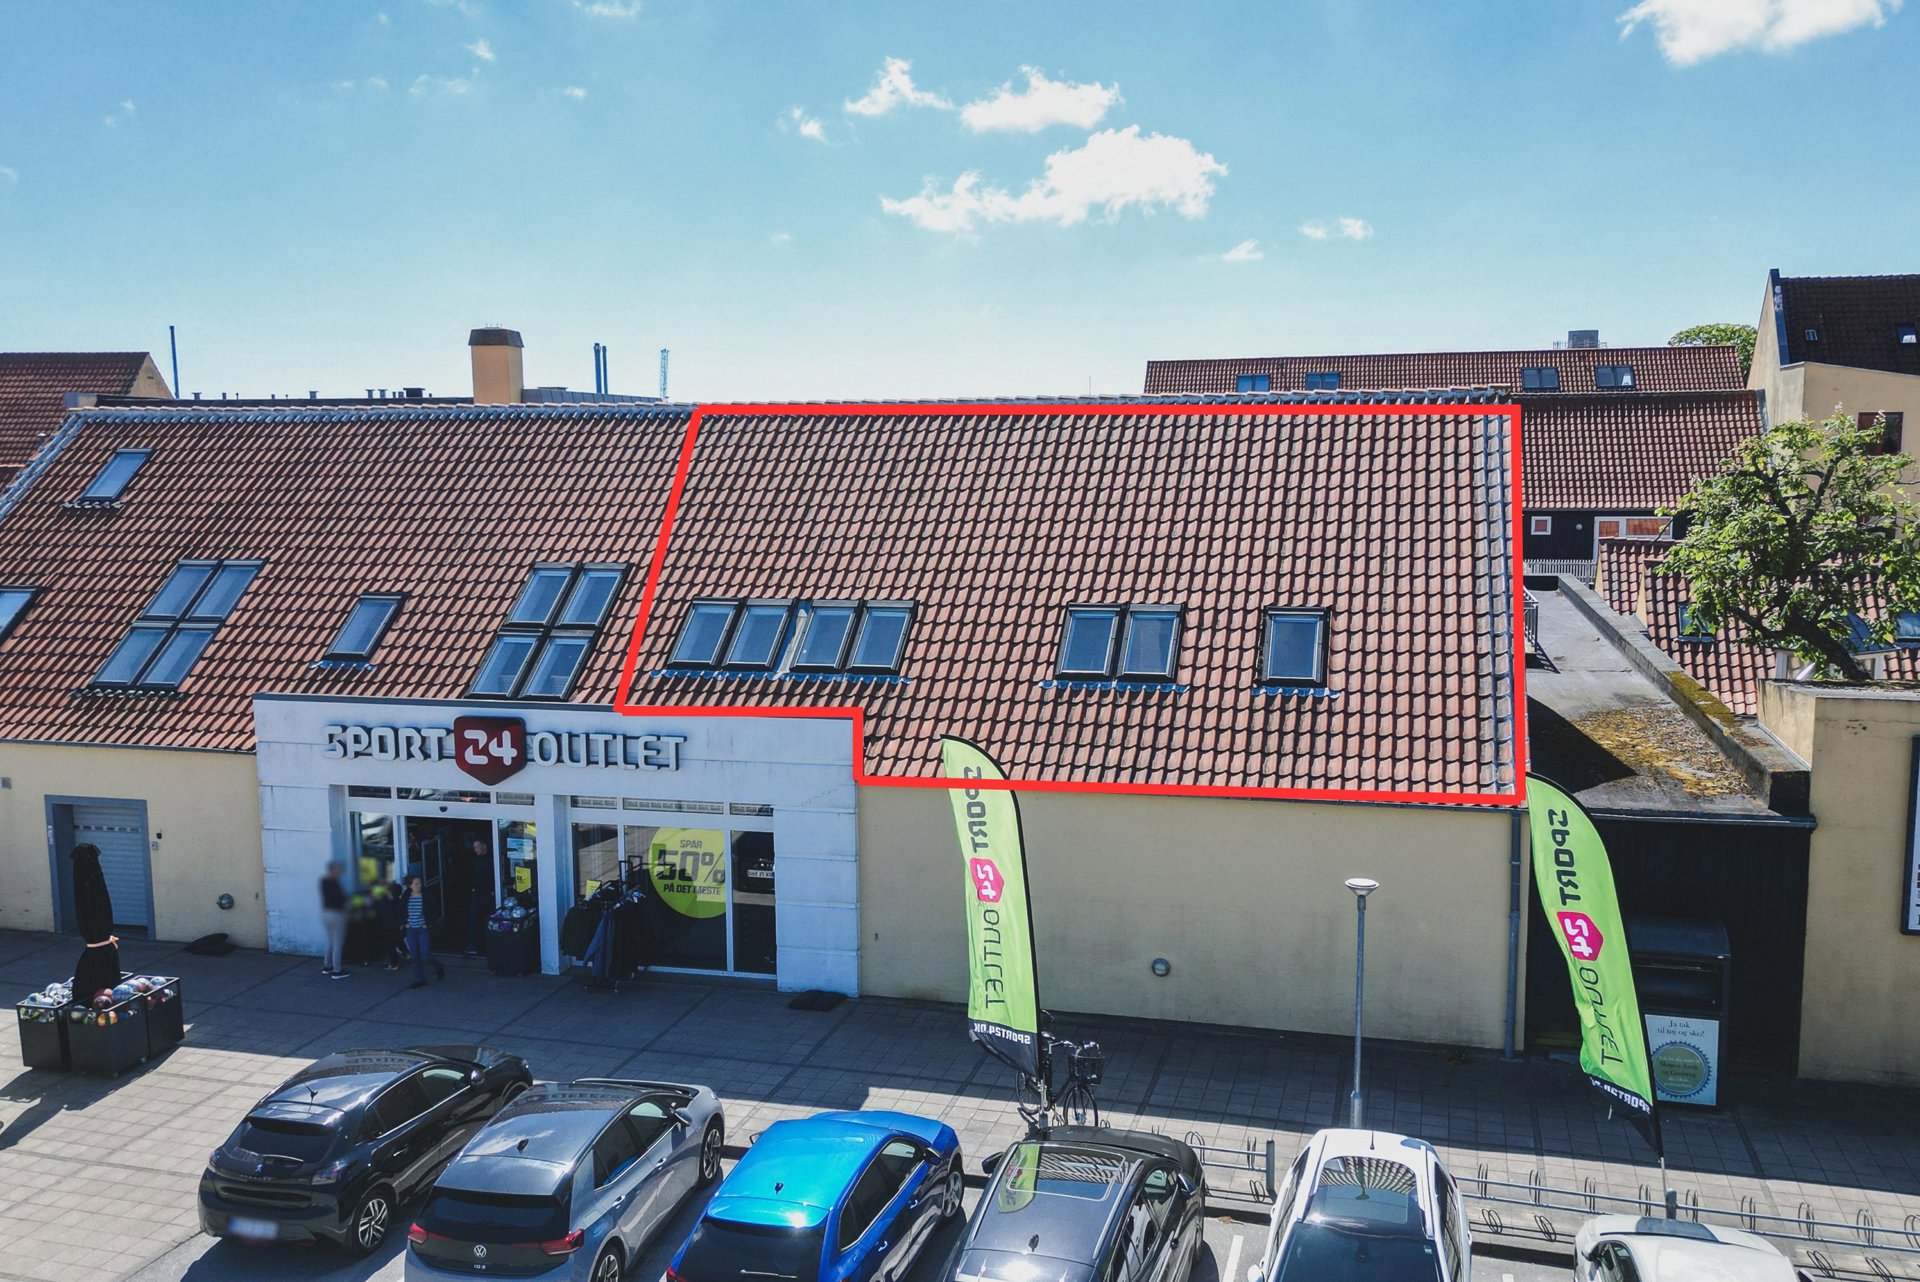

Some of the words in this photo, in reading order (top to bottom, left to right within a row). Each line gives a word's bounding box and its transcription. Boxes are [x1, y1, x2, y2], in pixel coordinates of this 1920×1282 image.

[322, 724, 450, 762] SPORT
[463, 729, 518, 767] 24
[532, 730, 687, 772] OUTLET
[680, 839, 702, 849] SPAR
[656, 849, 725, 884] 50%
[663, 883, 675, 893] PÅ
[676, 885, 692, 895] DET
[694, 886, 722, 896] MESTE
